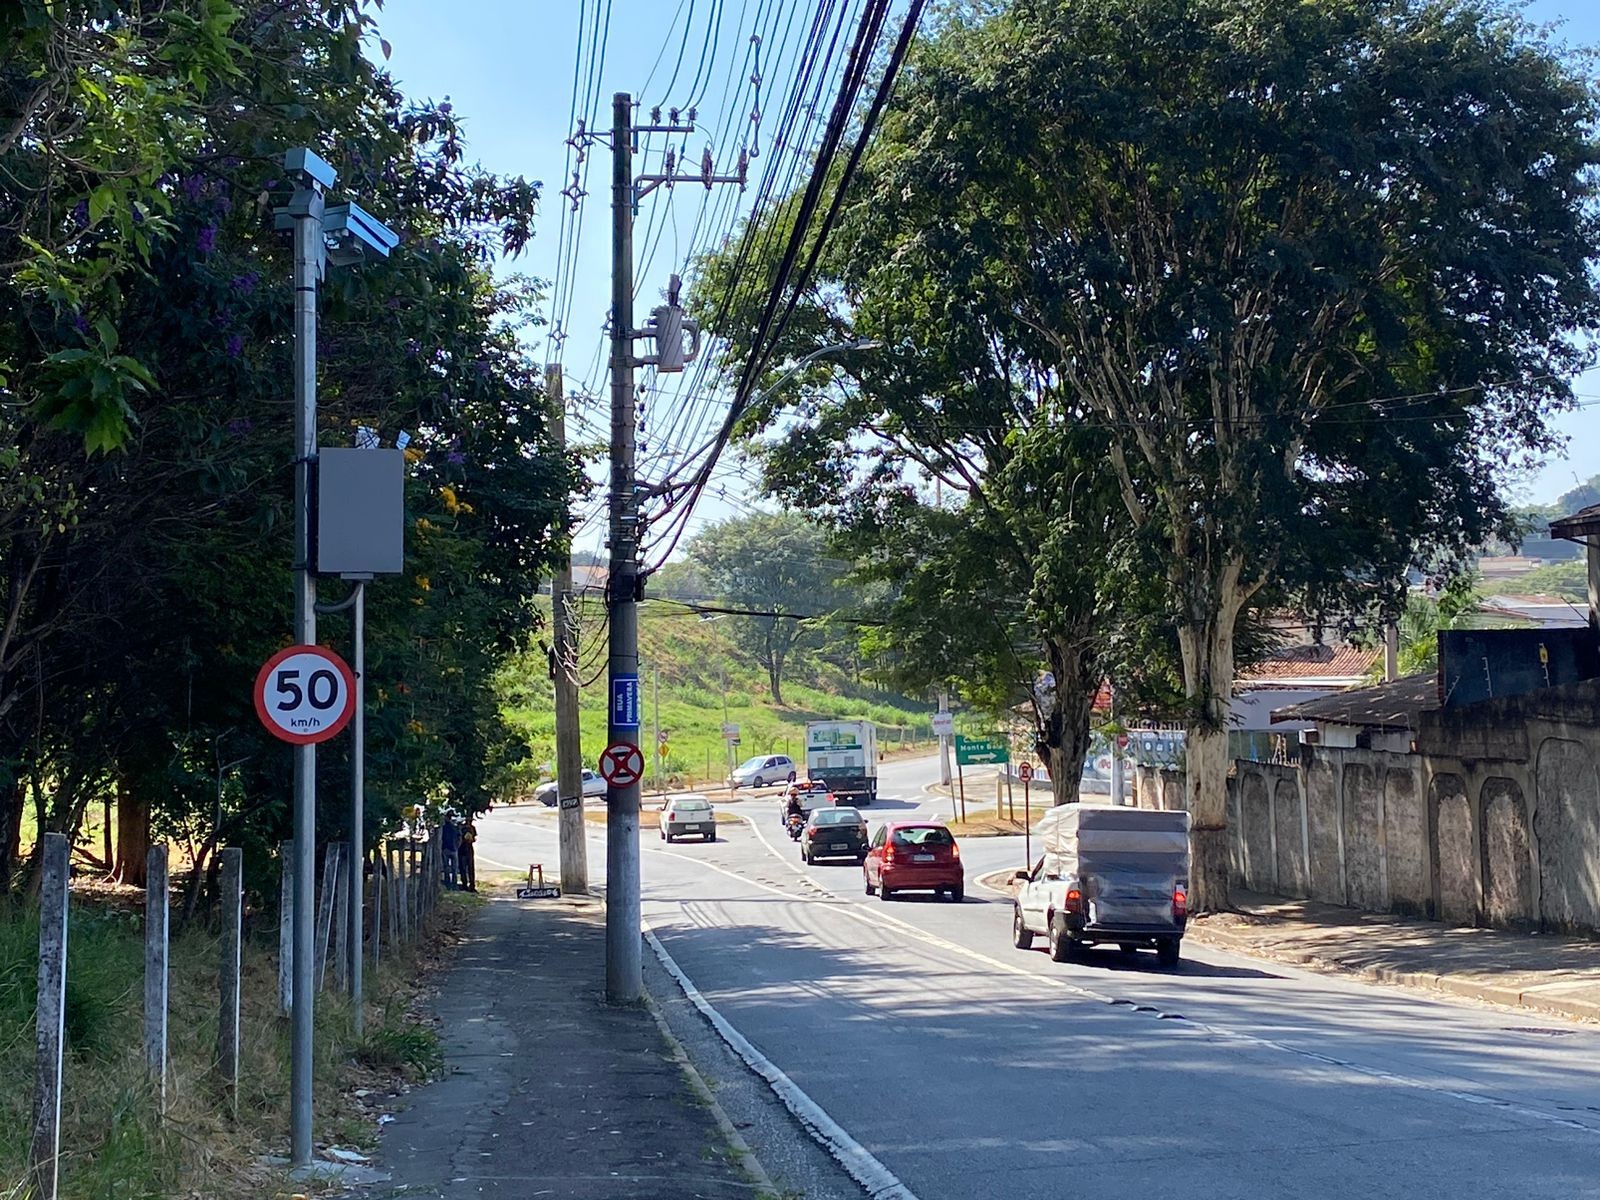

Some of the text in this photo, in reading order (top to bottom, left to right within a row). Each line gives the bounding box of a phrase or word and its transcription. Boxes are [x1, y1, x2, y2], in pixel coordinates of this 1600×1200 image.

[276, 669, 339, 712] 50
[616, 693, 624, 712] RUA
[290, 717, 321, 728] km/h
